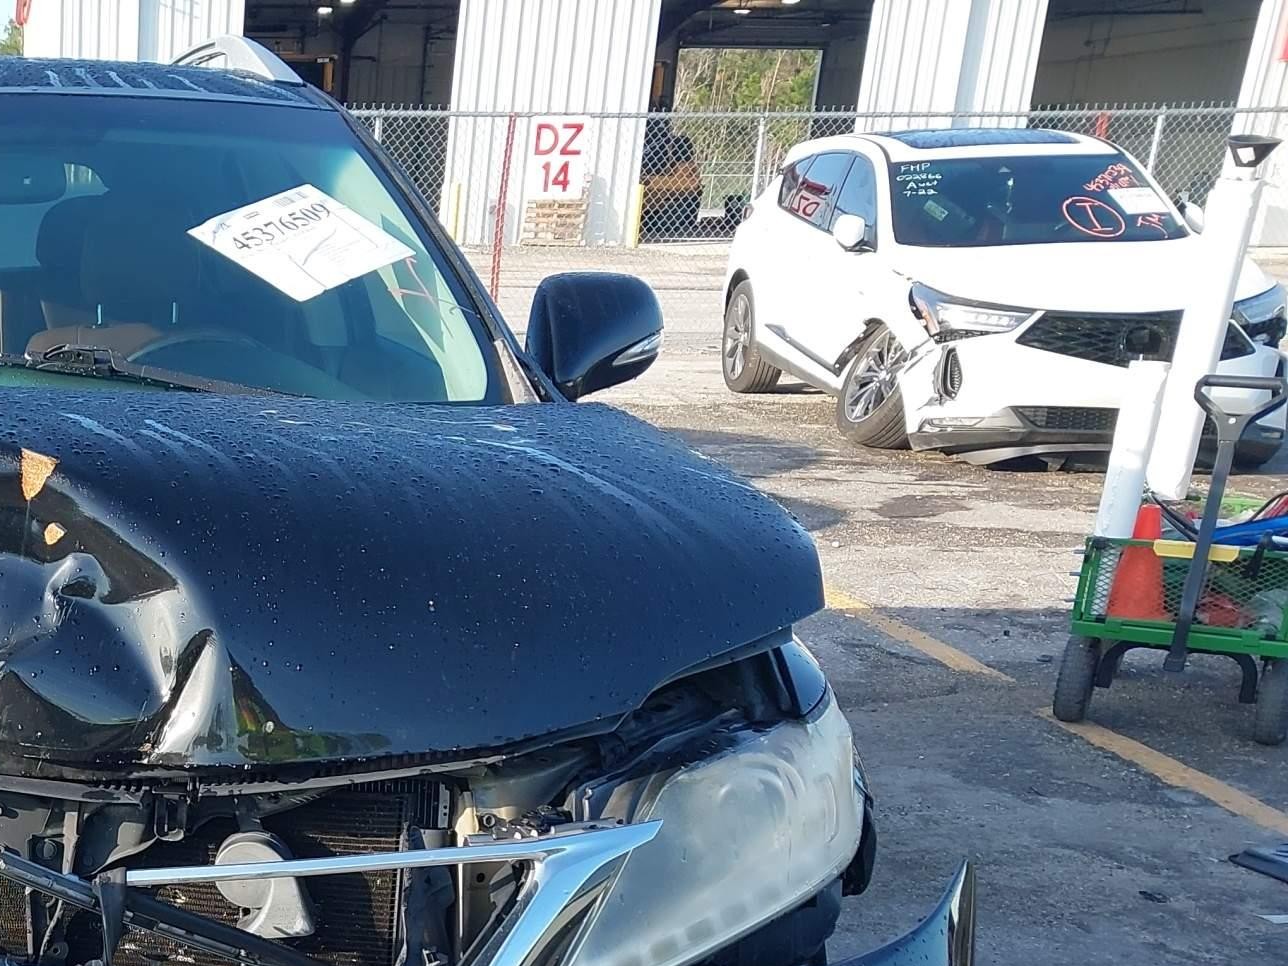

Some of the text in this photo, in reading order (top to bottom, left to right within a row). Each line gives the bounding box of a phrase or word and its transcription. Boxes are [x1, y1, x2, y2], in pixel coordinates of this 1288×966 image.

[534, 123, 584, 155] DZ
[542, 161, 570, 192] 14
[232, 203, 331, 249] 45376509
